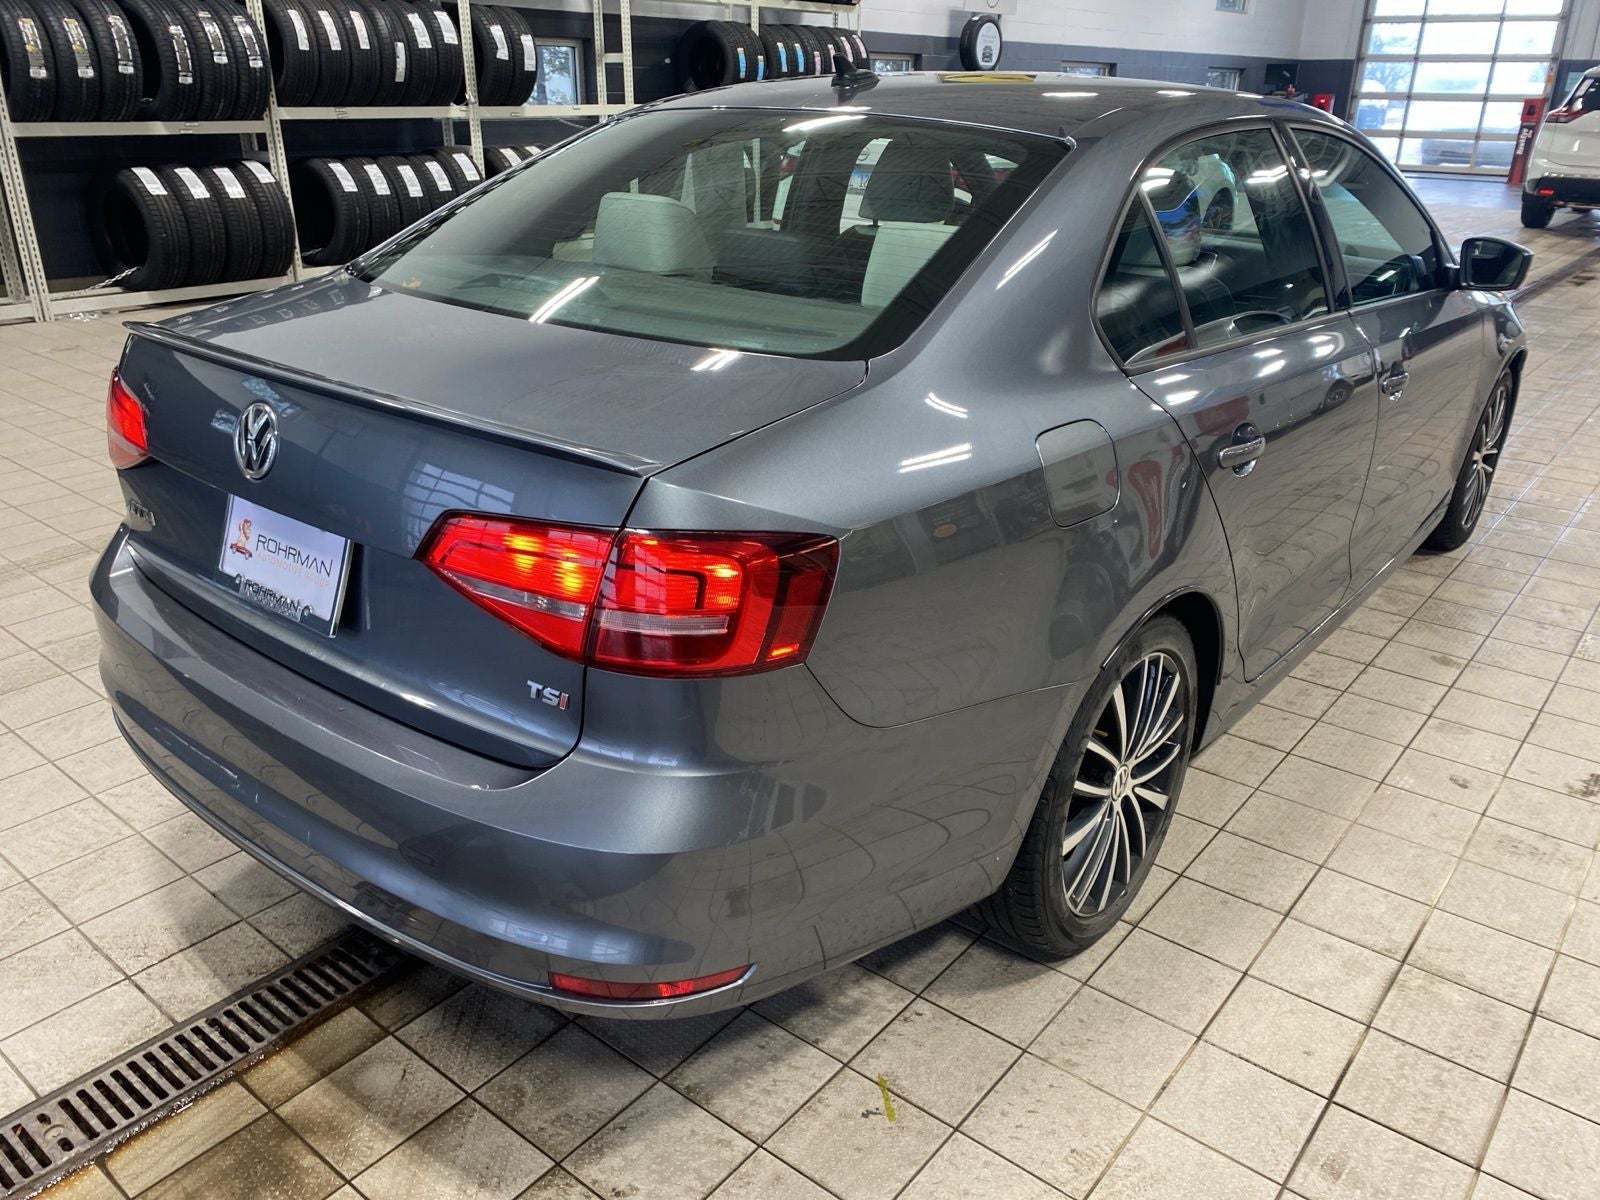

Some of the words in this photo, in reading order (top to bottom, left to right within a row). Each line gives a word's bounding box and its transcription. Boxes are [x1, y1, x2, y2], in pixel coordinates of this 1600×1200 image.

[256, 534, 333, 577] ROHRMAN
[245, 579, 300, 613] ROHRMAN
[527, 680, 569, 711] TSI
